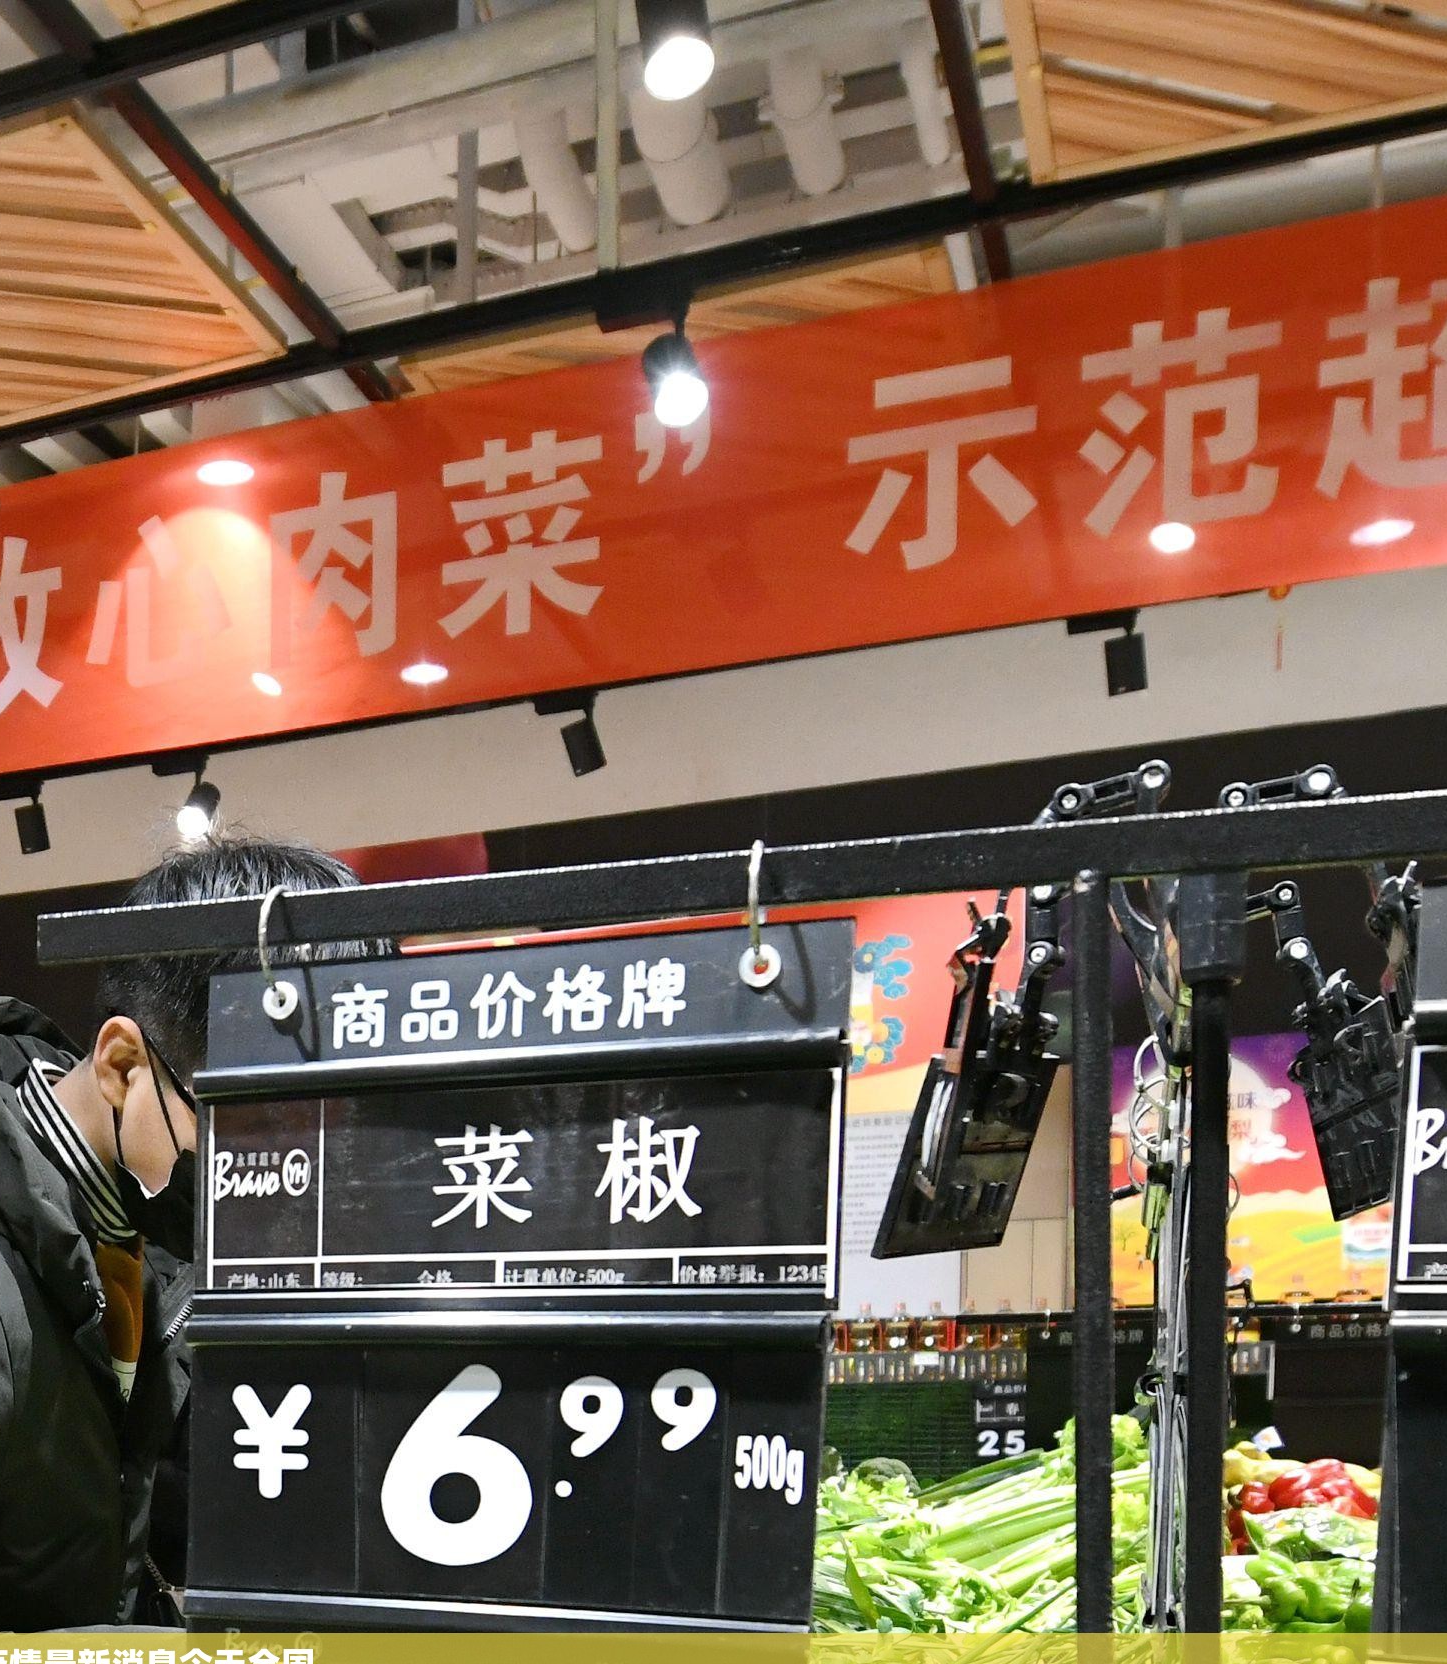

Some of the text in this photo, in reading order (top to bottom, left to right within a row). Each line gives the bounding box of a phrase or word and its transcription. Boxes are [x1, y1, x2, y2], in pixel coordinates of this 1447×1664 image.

[331, 957, 687, 1049] 商品价格牌
[214, 1150, 281, 1201] Bravo
[431, 1115, 703, 1229] 菜椒
[778, 1264, 828, 1282] 12345
[232, 1363, 806, 1567] ¥ 6.99 500g
